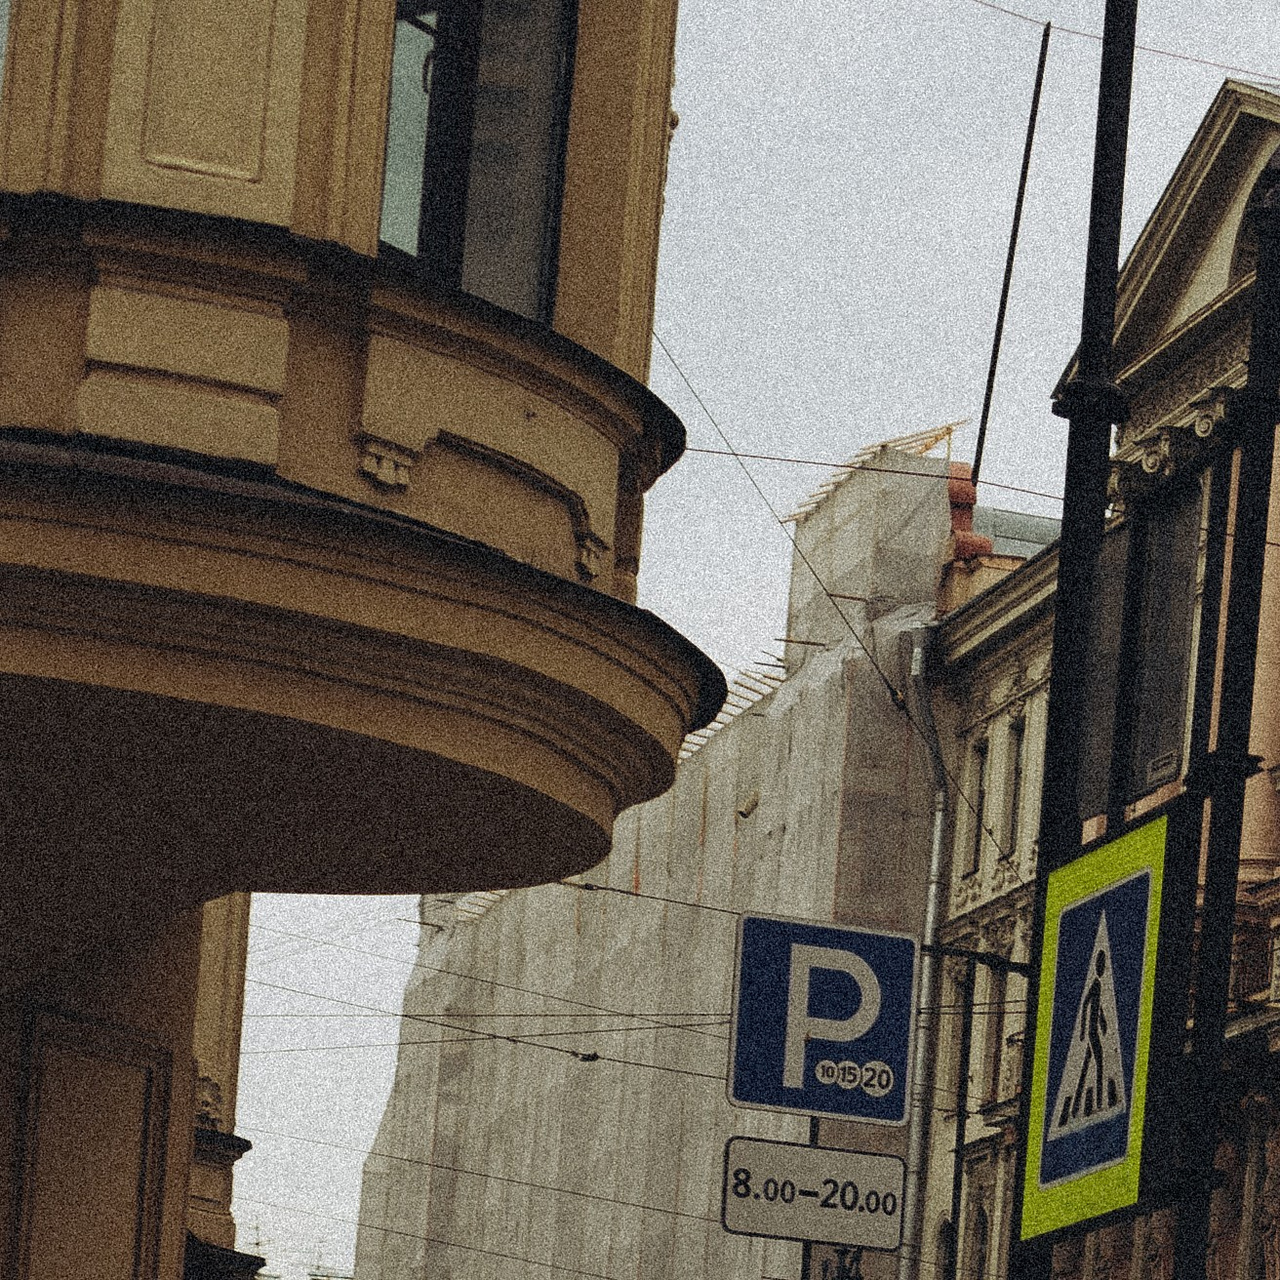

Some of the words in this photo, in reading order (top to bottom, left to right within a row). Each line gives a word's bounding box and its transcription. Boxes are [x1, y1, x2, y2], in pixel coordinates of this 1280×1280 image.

[782, 942, 882, 1089] P
[819, 1063, 836, 1080] 10
[840, 1064, 858, 1084] 15
[863, 1066, 892, 1090] 20
